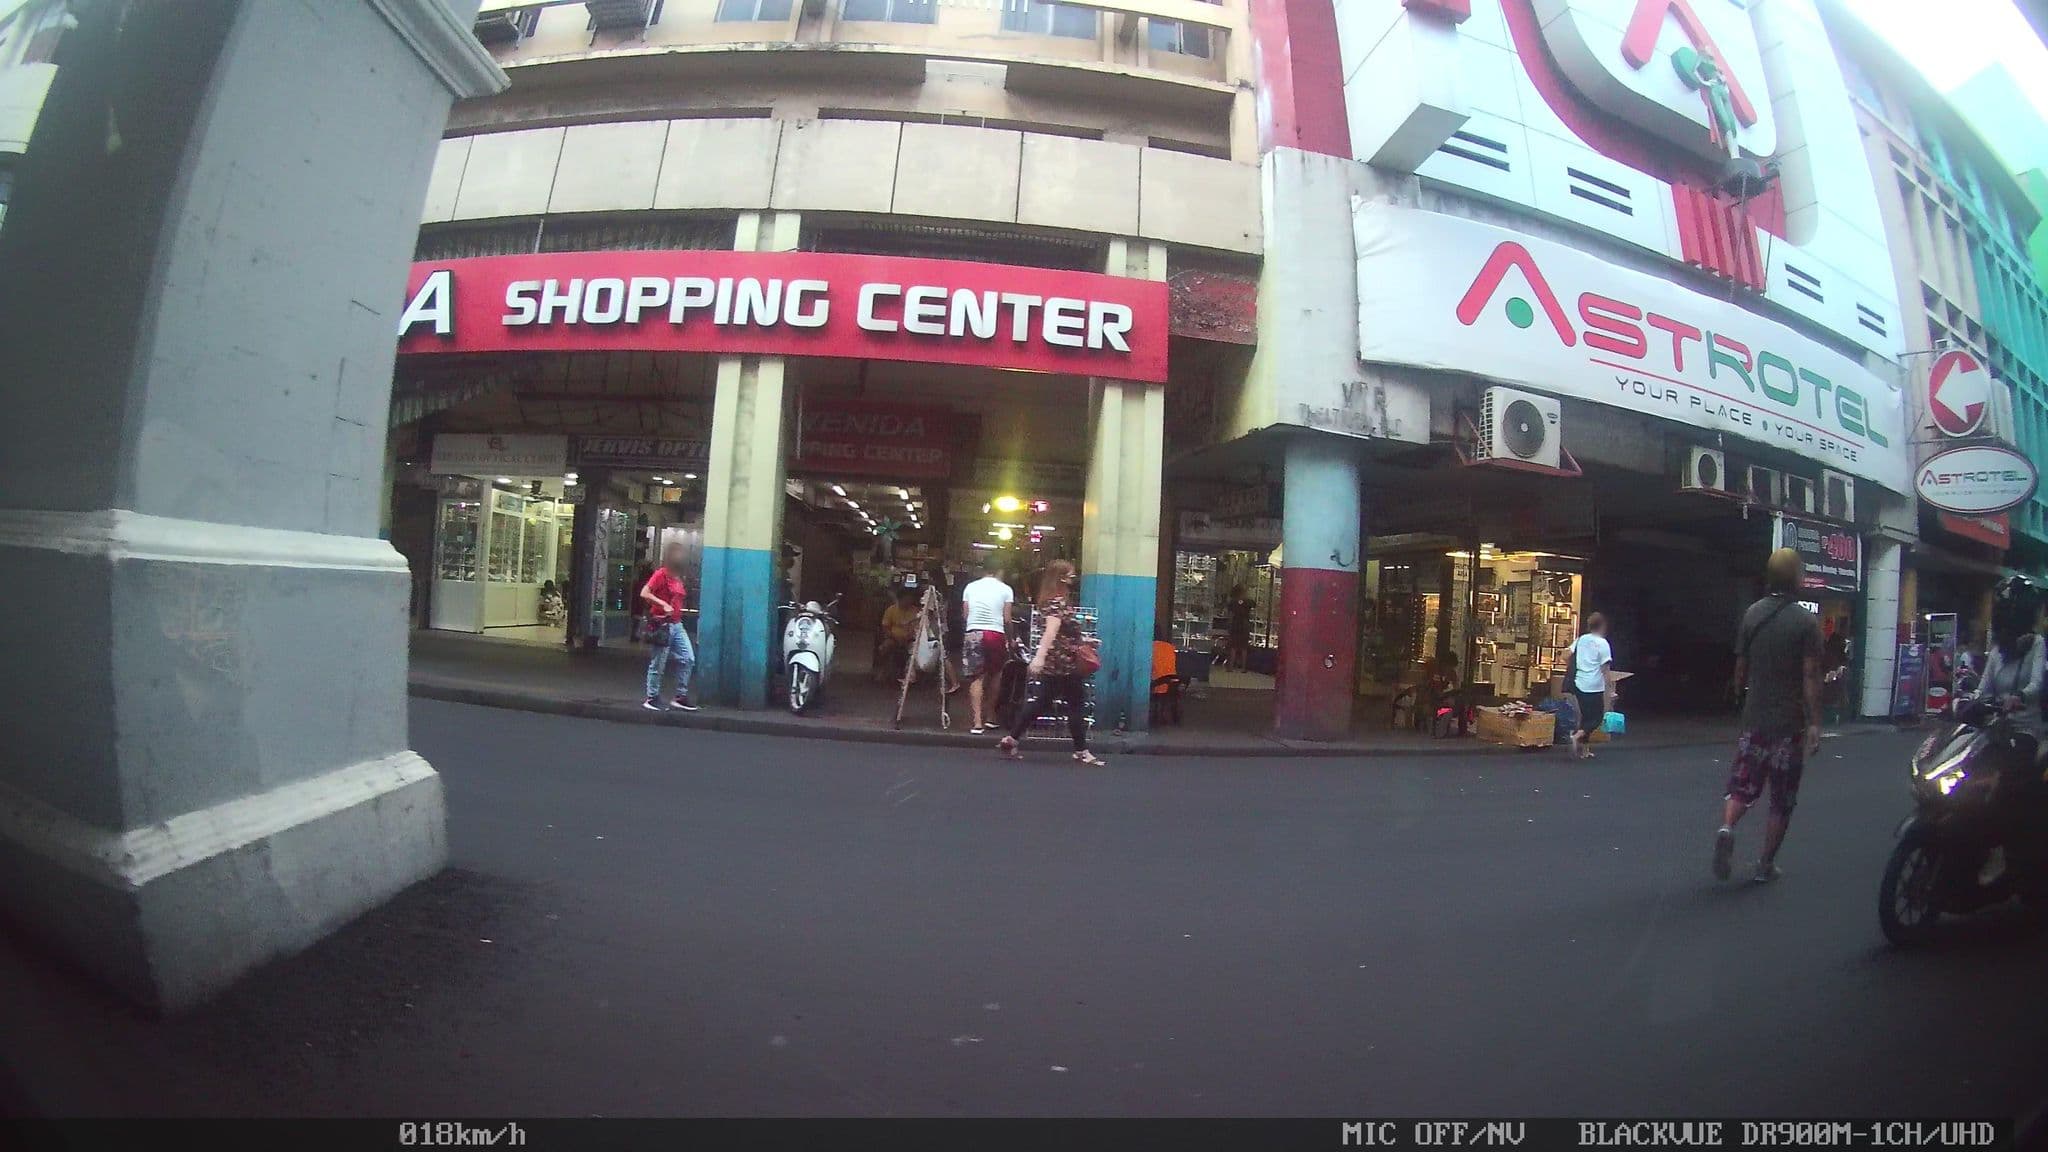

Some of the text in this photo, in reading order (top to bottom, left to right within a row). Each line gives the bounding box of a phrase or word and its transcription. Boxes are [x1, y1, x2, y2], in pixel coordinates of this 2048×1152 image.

[501, 277, 831, 328] SHOPPING
[856, 282, 1133, 353] CENTER
[1456, 241, 1889, 448] ASTROTEL
[1615, 376, 1857, 462] YOUR PLACE YOUR SPACE
[1920, 469, 2028, 486] ASTROTEL
